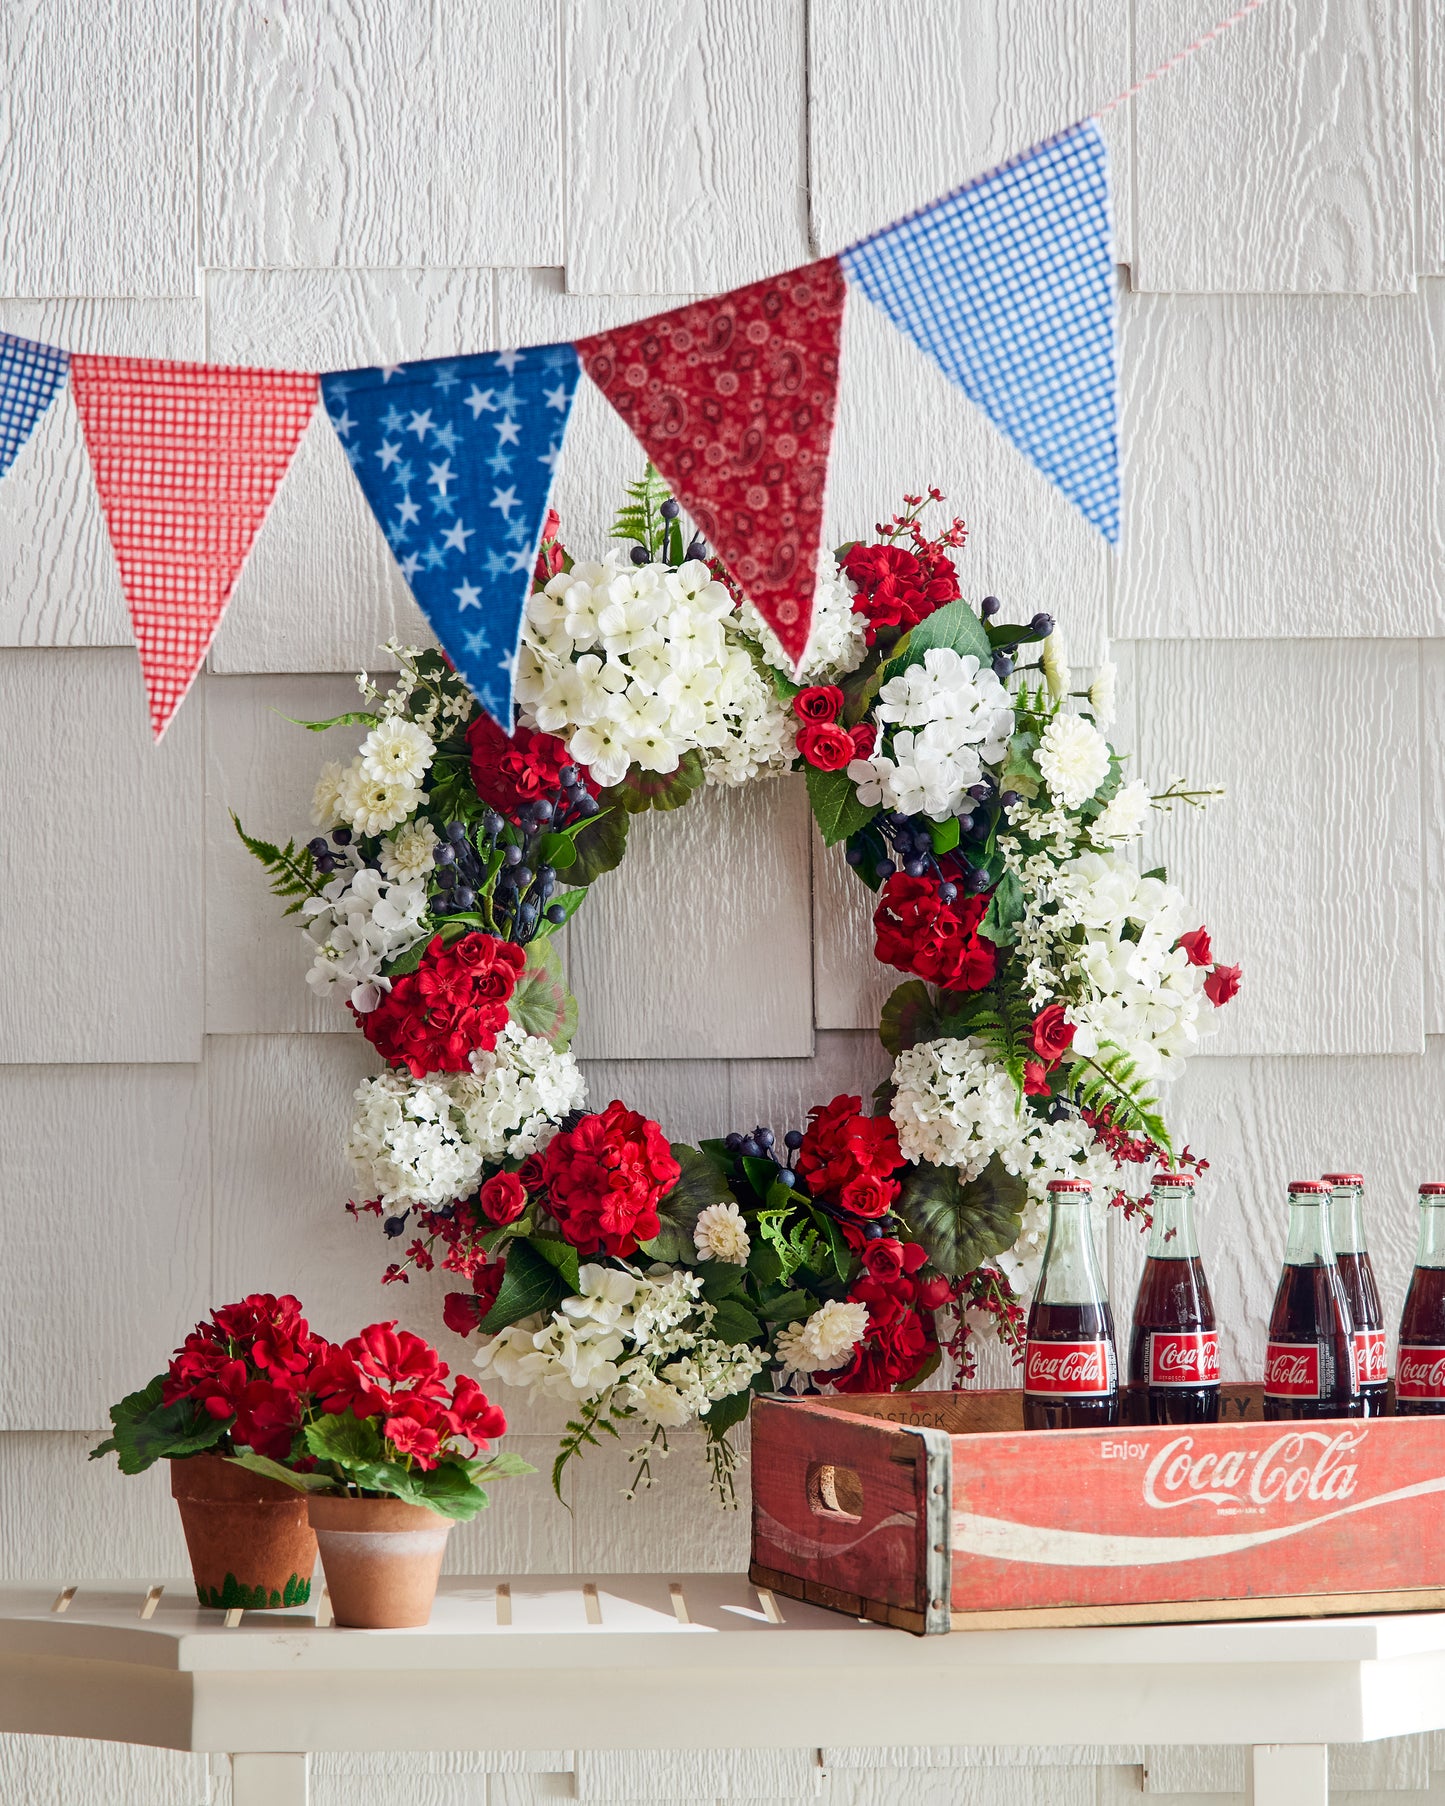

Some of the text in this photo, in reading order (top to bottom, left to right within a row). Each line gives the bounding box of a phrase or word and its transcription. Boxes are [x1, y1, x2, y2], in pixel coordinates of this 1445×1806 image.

[1028, 1351, 1099, 1381] Coca-Cola
[863, 1412, 945, 1428] DSTOCK
[1101, 1441, 1150, 1460] Enjoy
[1143, 1429, 1369, 1509] Coca-Cola
